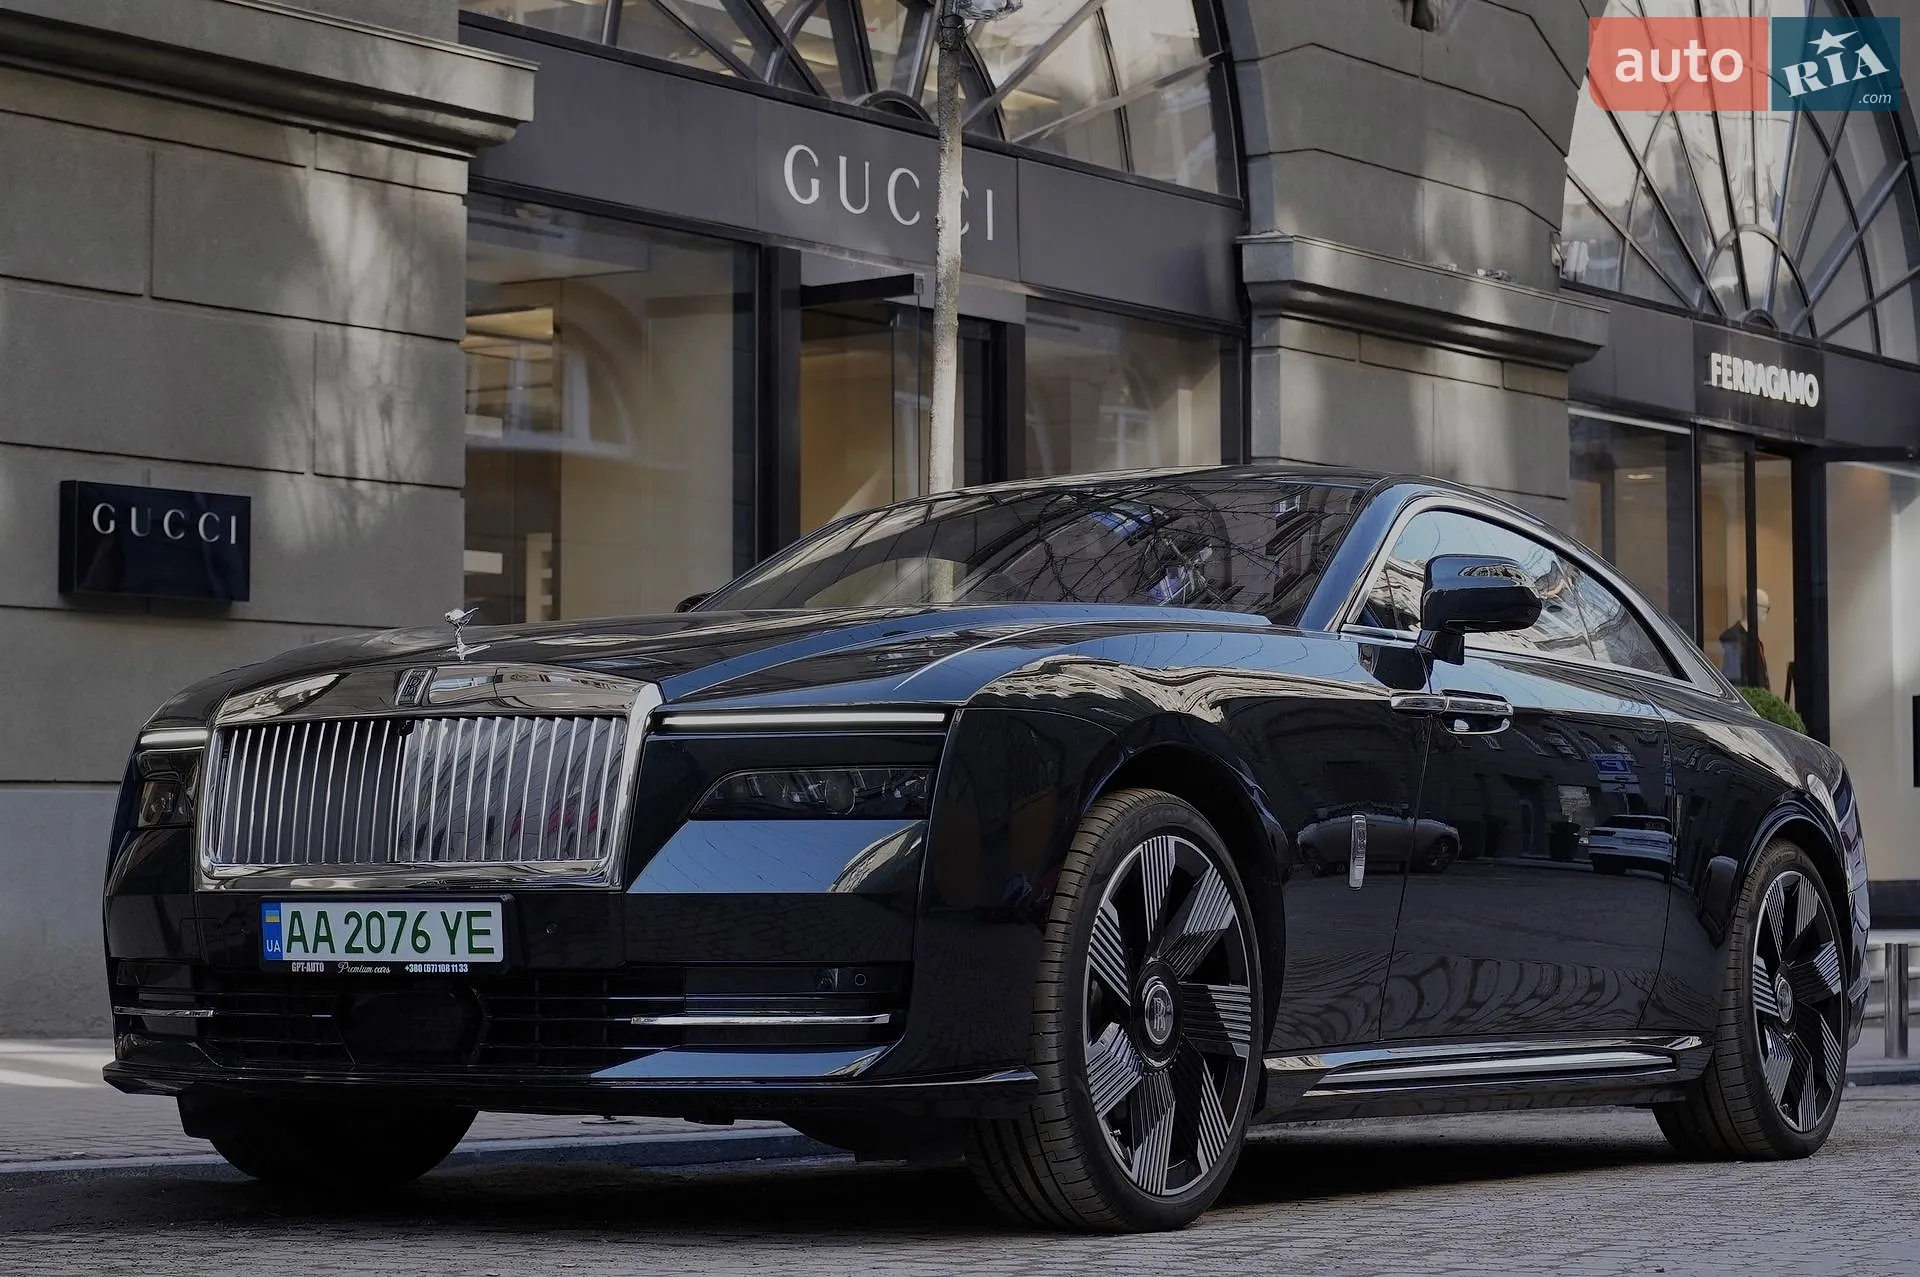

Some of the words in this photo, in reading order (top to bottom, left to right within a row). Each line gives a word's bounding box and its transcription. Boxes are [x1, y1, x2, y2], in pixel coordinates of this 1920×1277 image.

[784, 144, 993, 241] GUCI
[1711, 352, 1819, 408] FERRAGAMO
[92, 502, 237, 545] GUCCI
[265, 939, 282, 953] UA
[286, 910, 336, 954] AA
[344, 910, 432, 955] 2076
[440, 910, 495, 956] YE
